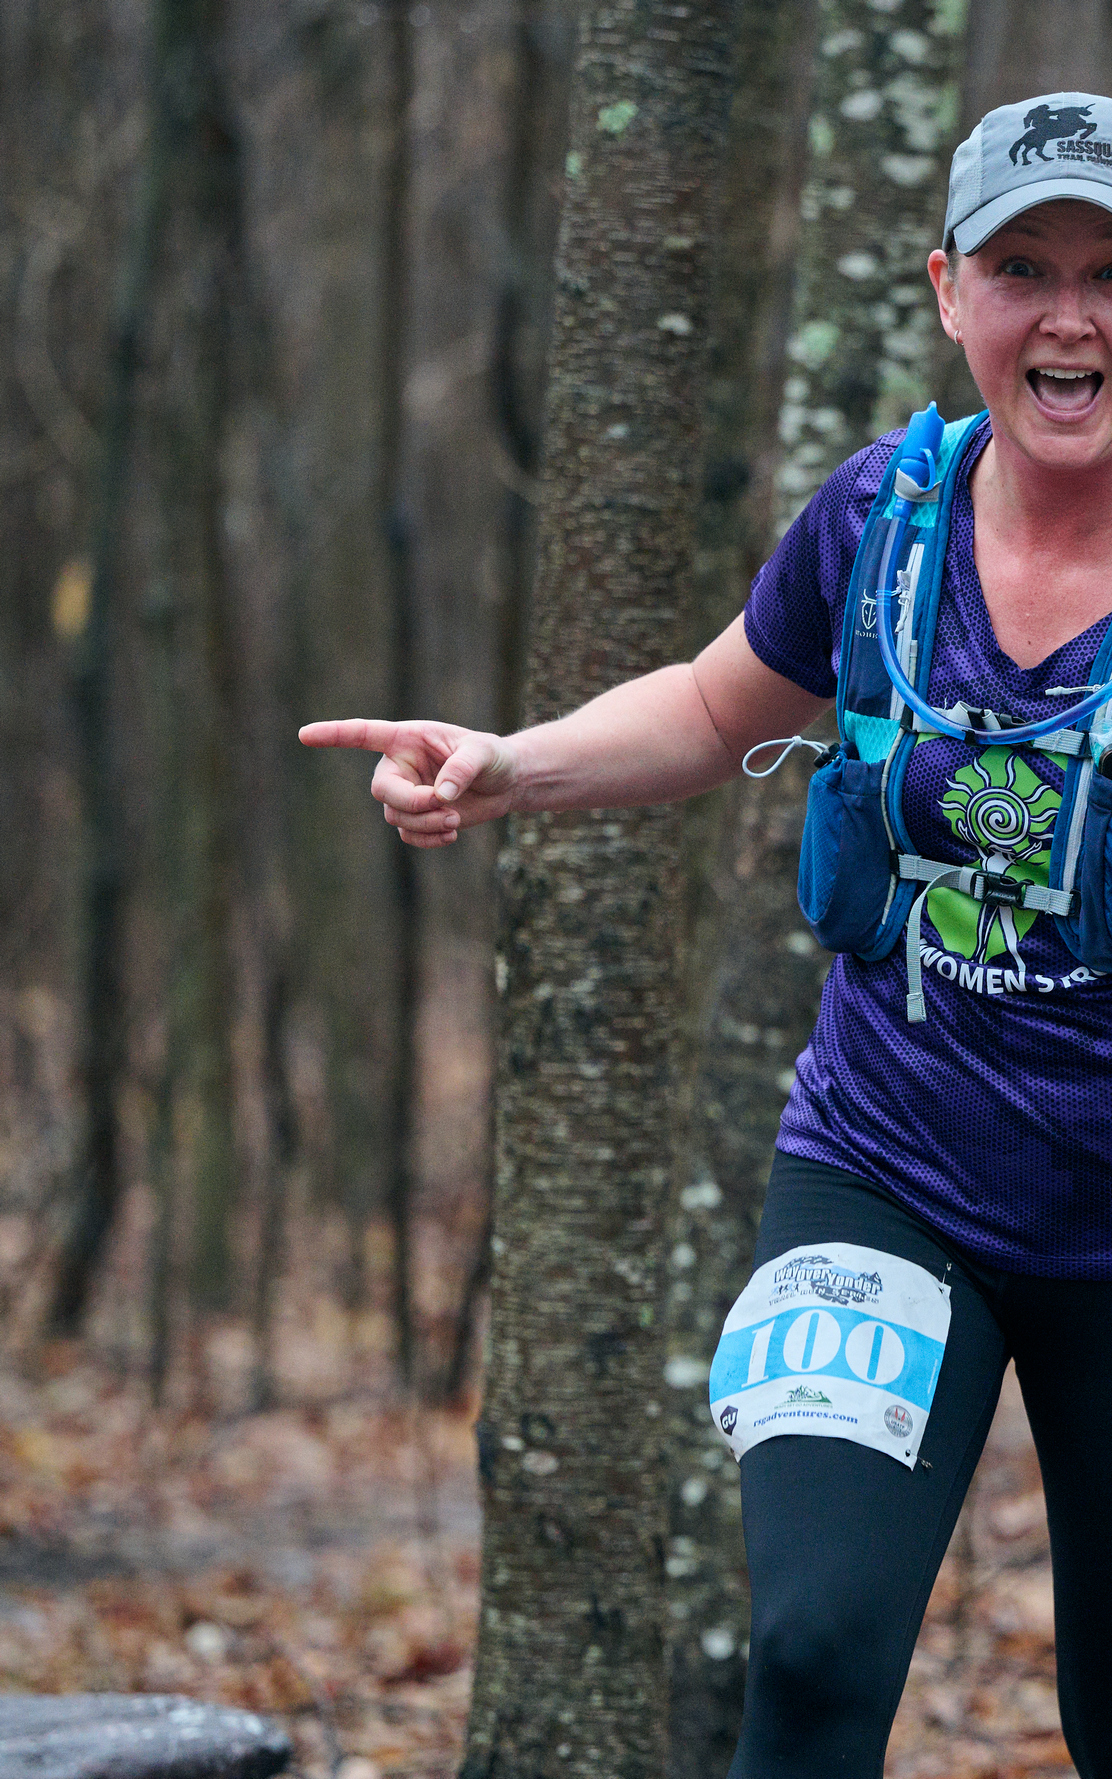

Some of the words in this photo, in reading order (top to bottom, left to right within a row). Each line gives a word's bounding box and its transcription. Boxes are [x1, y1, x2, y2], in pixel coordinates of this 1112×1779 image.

[741, 1309, 905, 1388] 100
[721, 1411, 737, 1429] GU
[753, 1410, 858, 1427] rsgadventures.com
